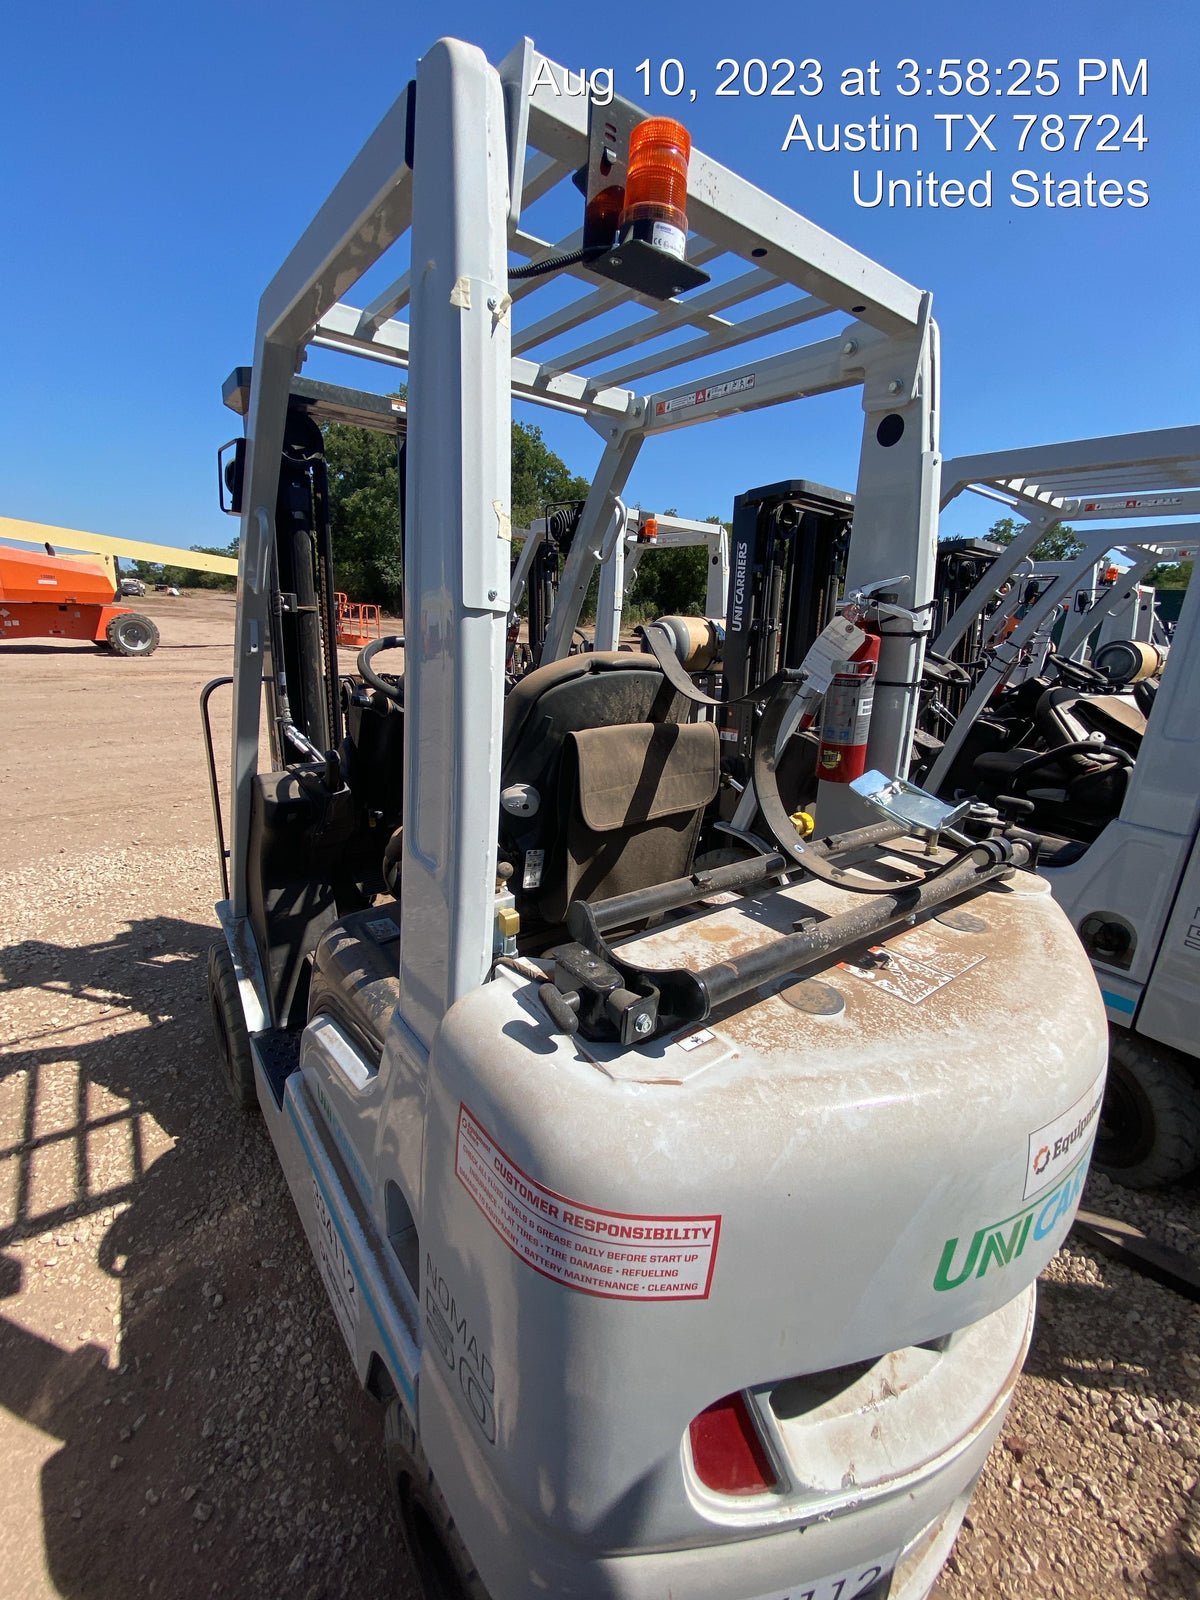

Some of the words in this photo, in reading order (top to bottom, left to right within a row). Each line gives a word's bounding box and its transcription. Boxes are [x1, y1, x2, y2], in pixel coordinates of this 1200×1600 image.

[732, 542, 748, 632] UNICARRIERS
[494, 1157, 560, 1219] CUSTOMER
[562, 1211, 713, 1241] RESPONSIBILITY
[504, 1197, 528, 1224] LEVELS
[536, 1225, 572, 1249] GREASE
[574, 1243, 605, 1258] DAILY
[606, 1252, 647, 1263] BEFORE
[650, 1254, 682, 1263] START
[684, 1254, 699, 1263] UP
[501, 1207, 515, 1226] FLAT
[516, 1223, 539, 1247] TIRES
[545, 1245, 567, 1261] TIRE
[570, 1256, 613, 1274] DAMAGE
[621, 1268, 679, 1277] REFUELING
[524, 1246, 562, 1274] BATTERY
[564, 1269, 639, 1292] MAINTENANCE
[647, 1282, 699, 1292] CLEANING
[427, 1252, 496, 1394] NOMAD
